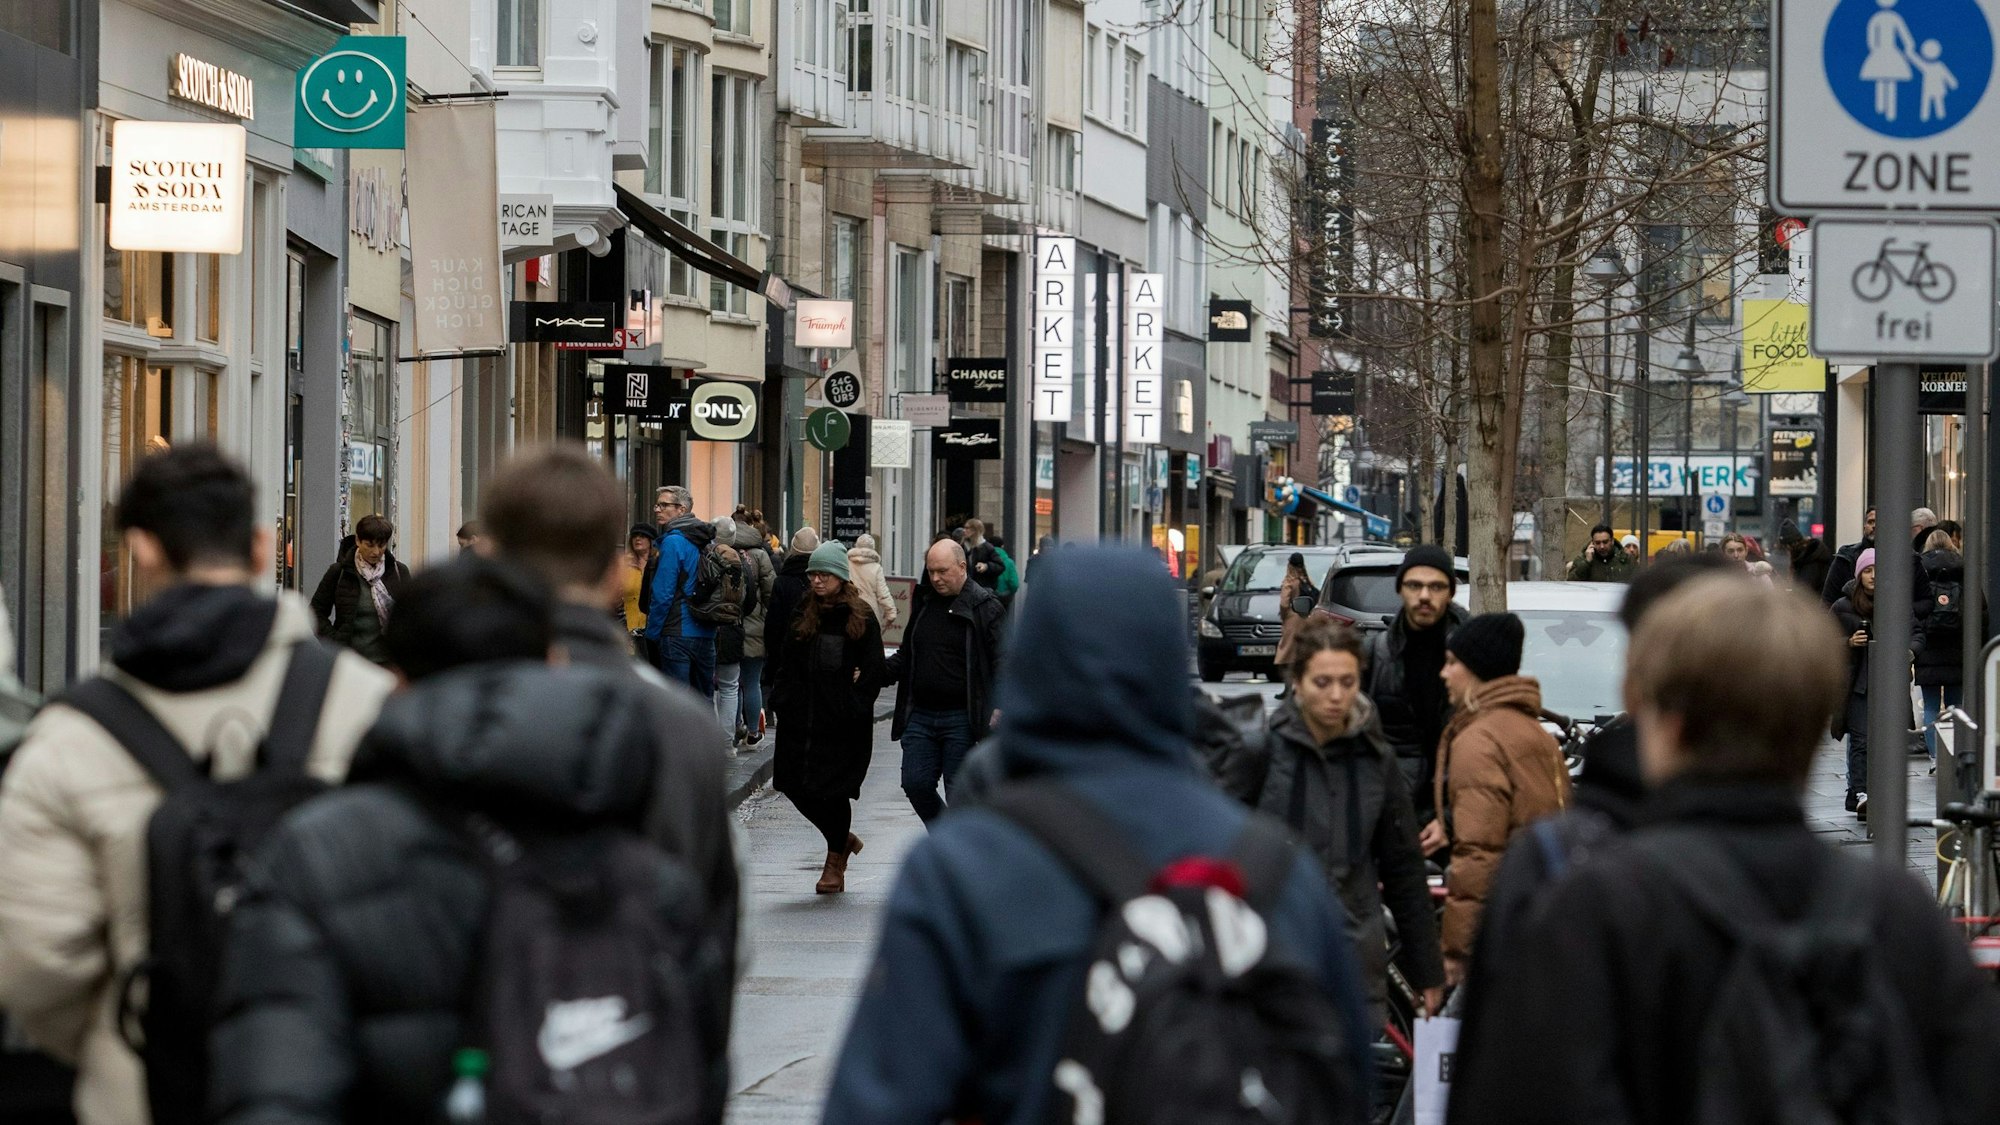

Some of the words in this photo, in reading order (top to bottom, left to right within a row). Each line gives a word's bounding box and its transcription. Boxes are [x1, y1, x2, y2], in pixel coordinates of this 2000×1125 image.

[178, 53, 219, 108] SCOTCH
[227, 70, 254, 120] SODA
[129, 159, 223, 178] SCOTCH
[1843, 153, 1972, 193] ZONE
[132, 181, 149, 198] &
[157, 182, 222, 199] SODA
[127, 202, 224, 213] AMSTERDAM
[502, 204, 547, 218] RICAN
[501, 222, 540, 235] TAGE
[800, 316, 847, 335] Triumph
[1044, 244, 1067, 415] ARKET
[1761, 321, 1809, 344] littl
[1876, 312, 1932, 342] frei
[1135, 279, 1155, 437] ARKET
[1753, 344, 1814, 359] FOOD
[831, 375, 852, 388] 24C
[951, 369, 1005, 380] CHANGE
[1922, 372, 1967, 382] YELLOW
[831, 384, 854, 396] OLO
[832, 392, 855, 404] URS
[694, 402, 752, 419] ONLY
